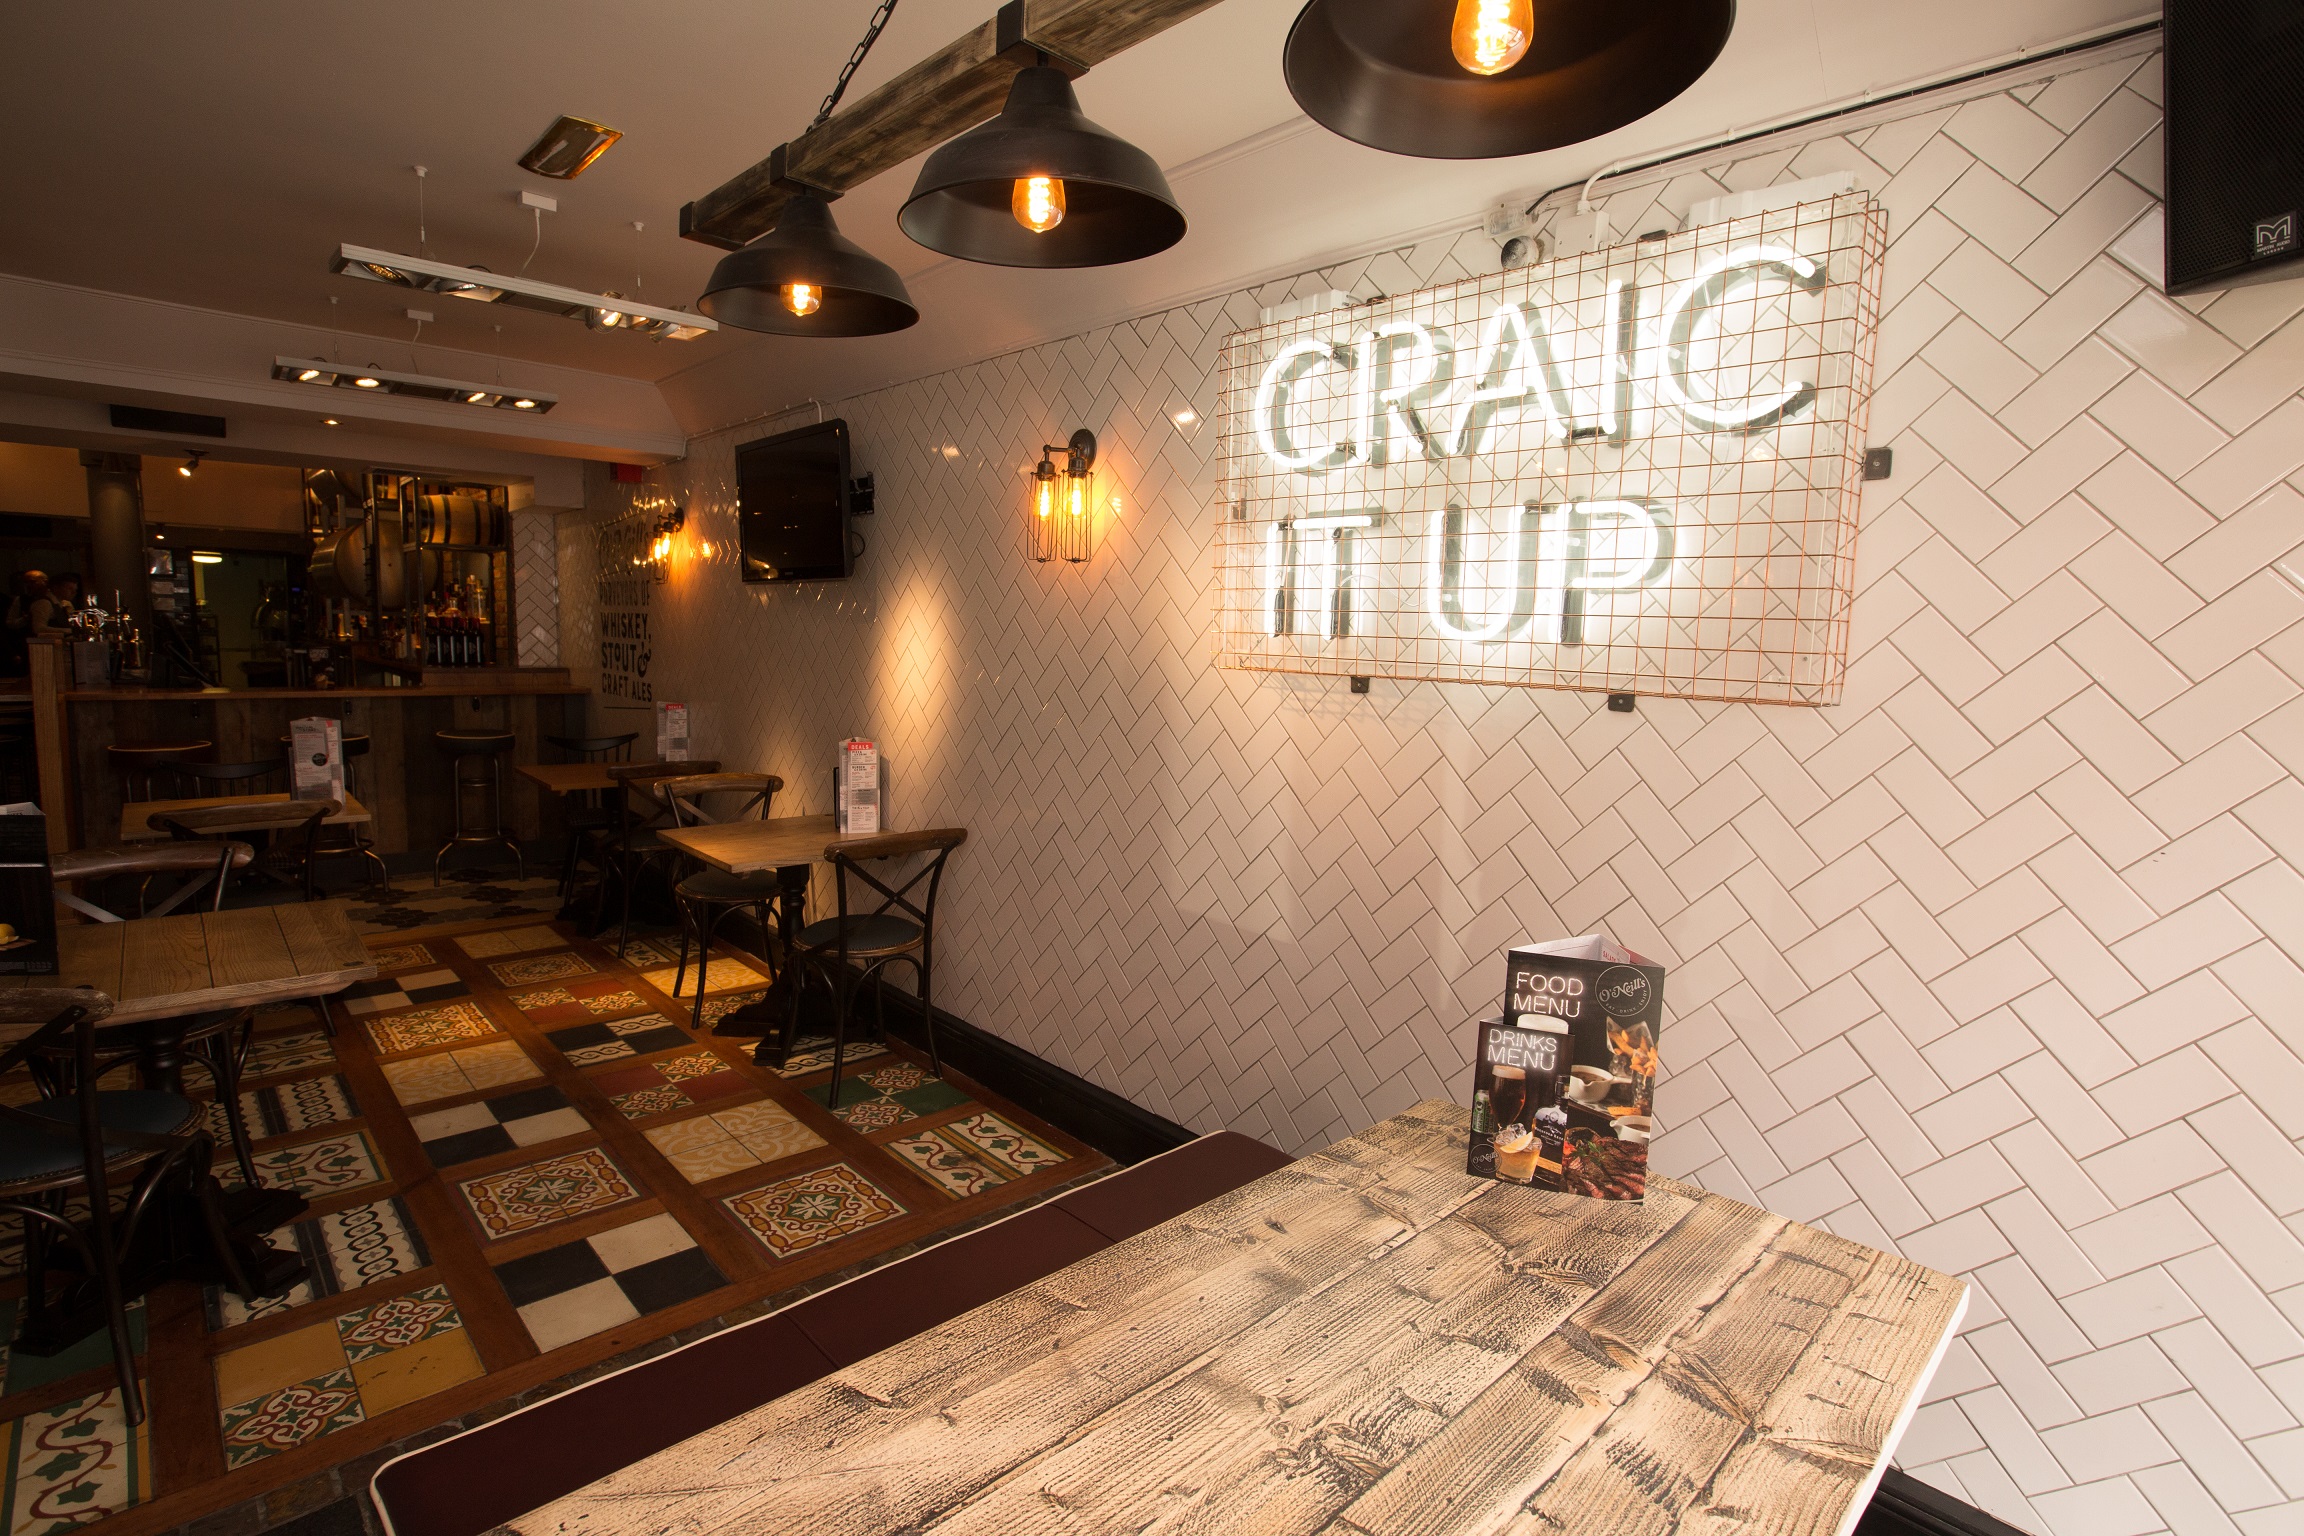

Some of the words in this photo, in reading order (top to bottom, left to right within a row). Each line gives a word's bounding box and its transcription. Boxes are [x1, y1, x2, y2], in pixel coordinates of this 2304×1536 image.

[1255, 245, 1821, 470] CRAIC
[1265, 510, 1378, 640] IT
[1427, 498, 1668, 644] UP
[600, 612, 651, 643] WHISKEY,
[601, 641, 637, 672] STOUT
[637, 641, 652, 678] &
[601, 672, 629, 697] CRAFT
[631, 680, 652, 703] ALES
[1516, 971, 1584, 996] FOOD
[1599, 978, 1646, 1003] O'Neill's
[1513, 992, 1581, 1018] MENU
[1489, 1028, 1558, 1053] DRINKS
[1487, 1044, 1556, 1071] MENU
